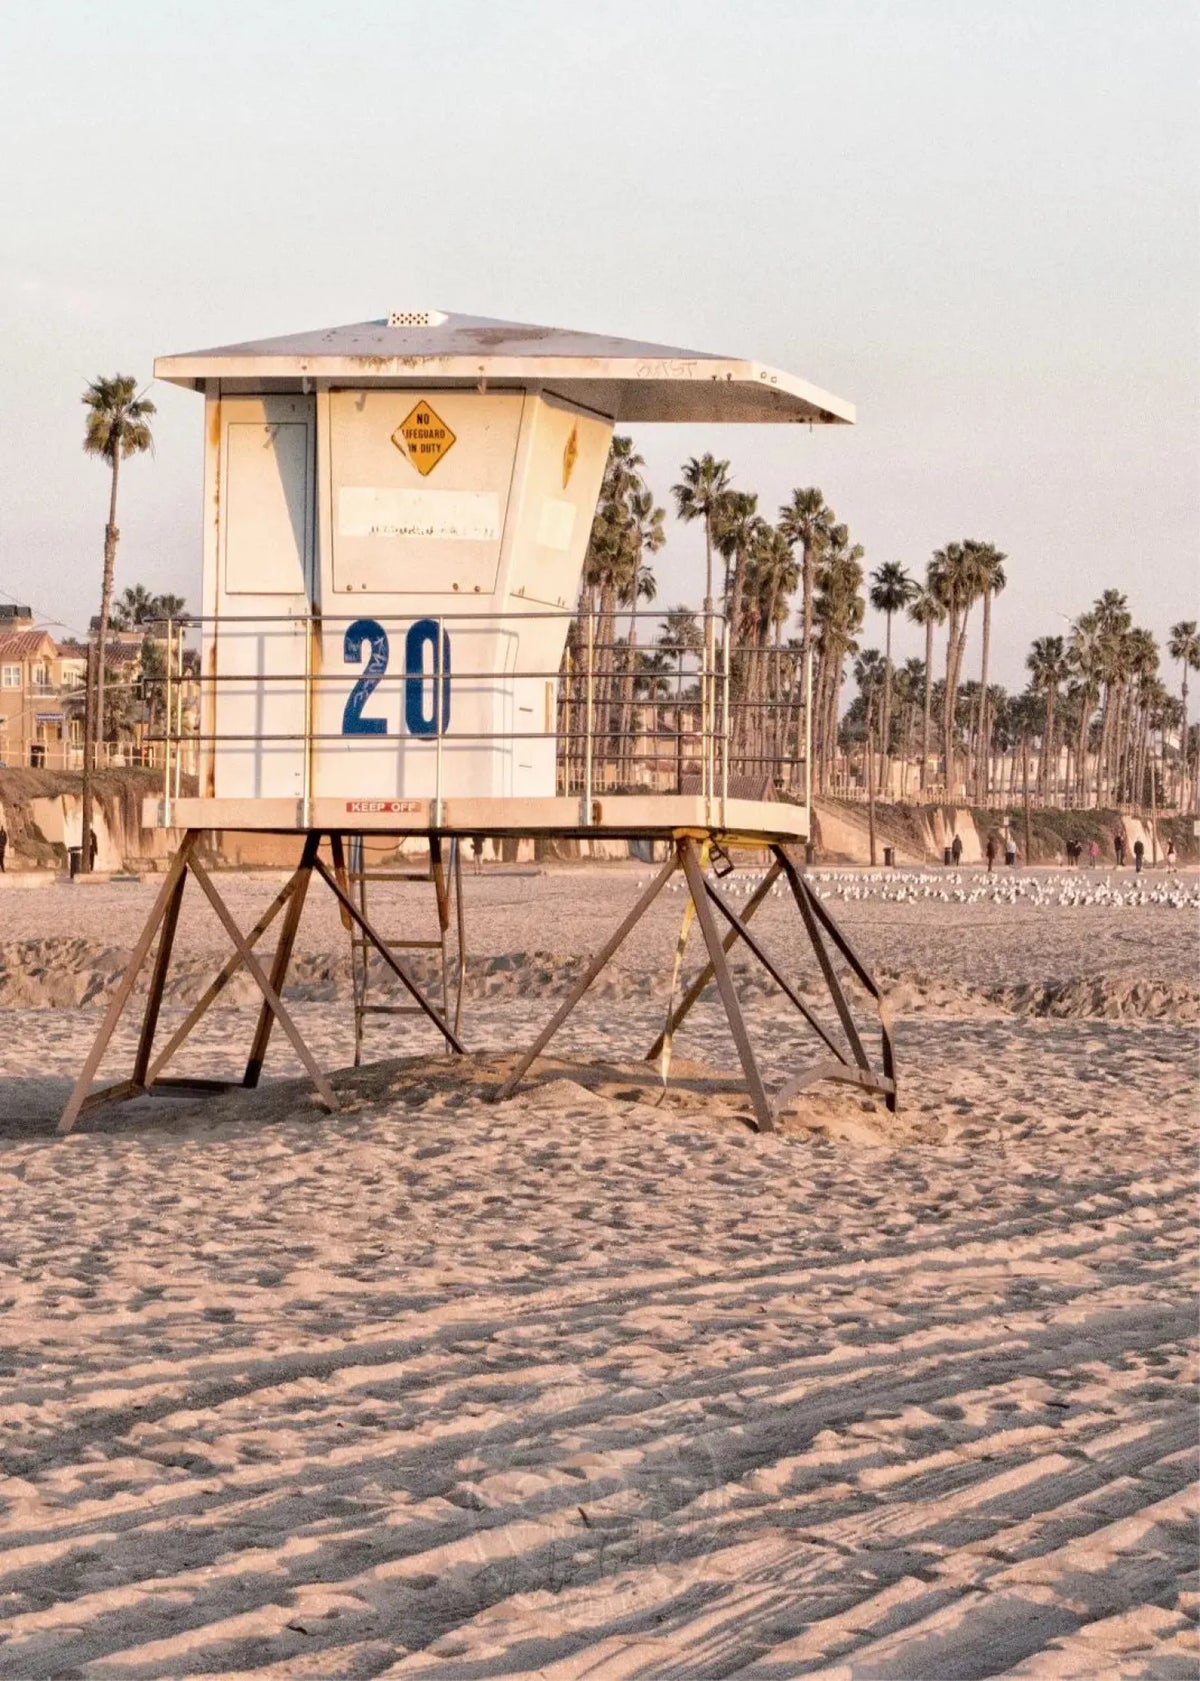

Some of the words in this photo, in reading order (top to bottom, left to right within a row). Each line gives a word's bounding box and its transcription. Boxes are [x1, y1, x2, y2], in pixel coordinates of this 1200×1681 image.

[416, 413, 430, 425] NO
[421, 443, 441, 453] DUTY
[342, 618, 451, 741] 20
[351, 802, 386, 812] KEEP
[390, 802, 416, 812] OFF
